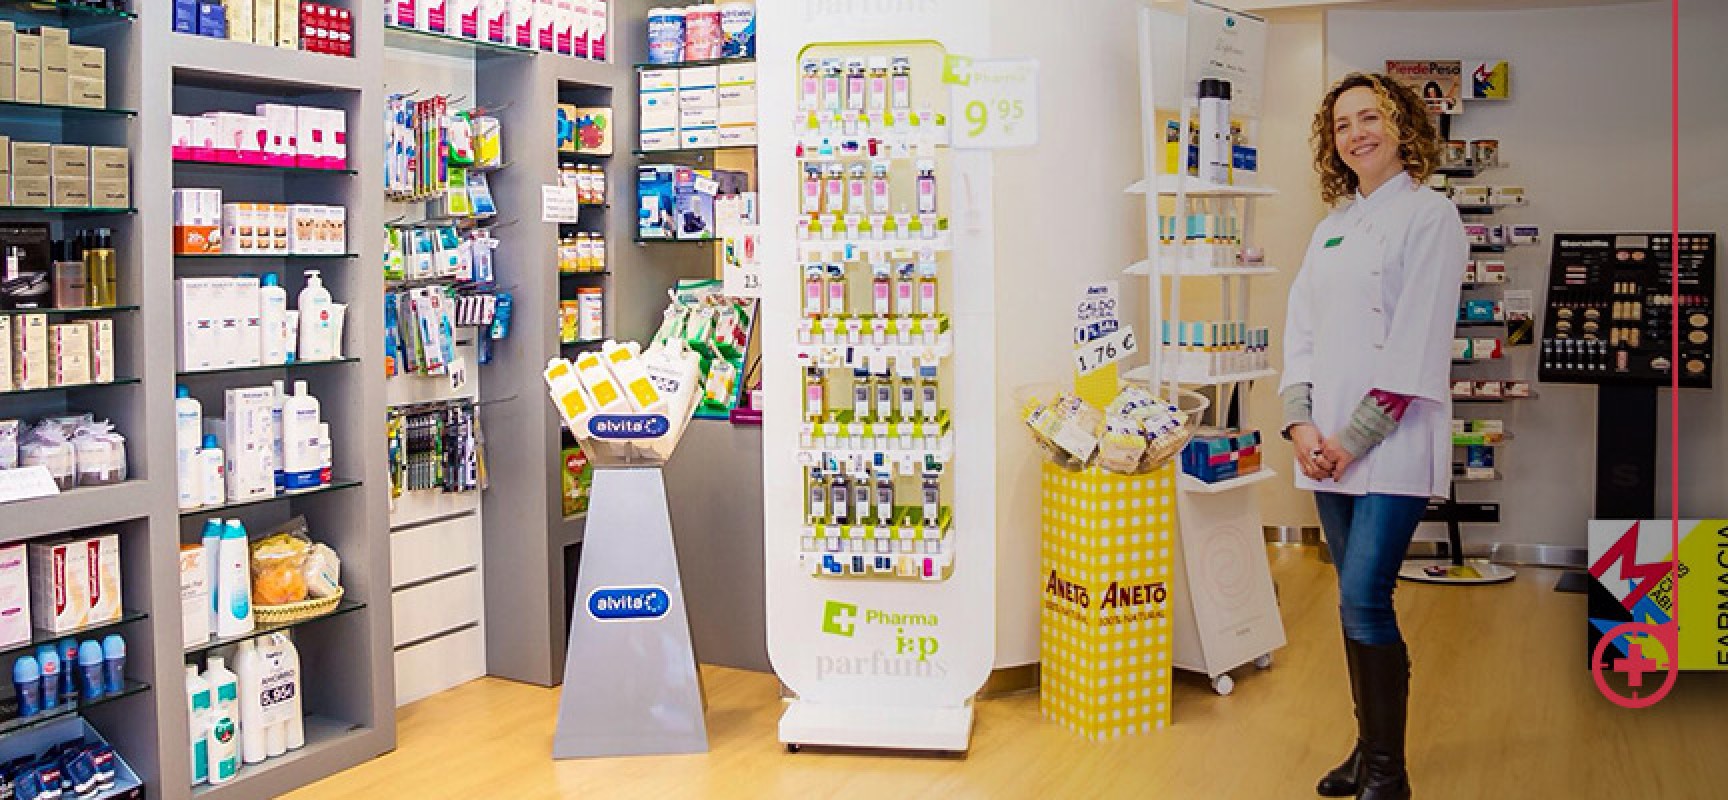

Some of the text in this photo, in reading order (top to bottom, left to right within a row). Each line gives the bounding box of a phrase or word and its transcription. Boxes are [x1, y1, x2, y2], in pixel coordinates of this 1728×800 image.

[597, 419, 643, 432] alvita
[1046, 569, 1091, 609] ANETO
[1100, 581, 1167, 610] ANETO
[597, 595, 643, 611] alvita
[865, 609, 939, 626] Pharma
